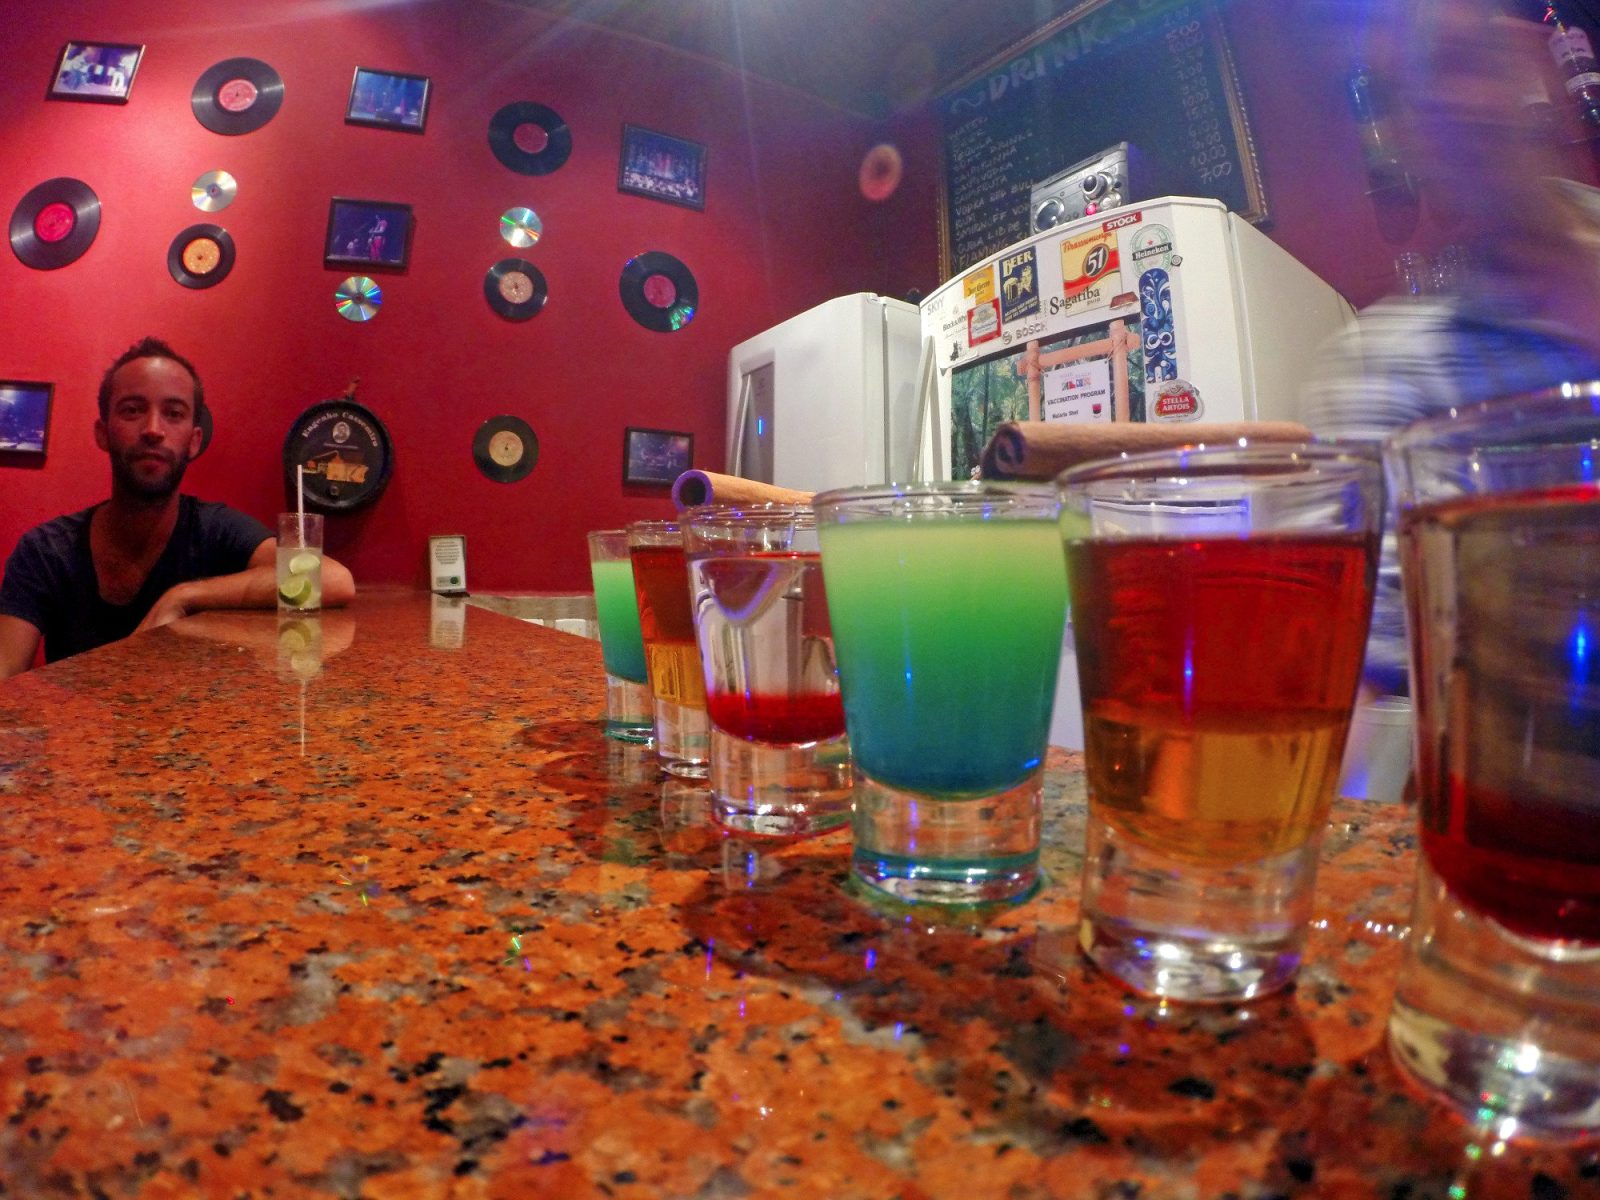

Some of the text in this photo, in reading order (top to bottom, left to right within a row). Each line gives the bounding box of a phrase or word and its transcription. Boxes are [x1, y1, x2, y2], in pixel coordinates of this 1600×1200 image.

[1107, 214, 1137, 230] STOCK
[1135, 243, 1170, 259] Heineken
[1003, 251, 1033, 277] BEER
[1087, 247, 1105, 276] 51
[927, 296, 945, 316] SKYY
[1049, 286, 1100, 315] Sagatiba
[1047, 389, 1106, 405] VACCINATION PROGRAM
[1162, 396, 1190, 405] STELLA
